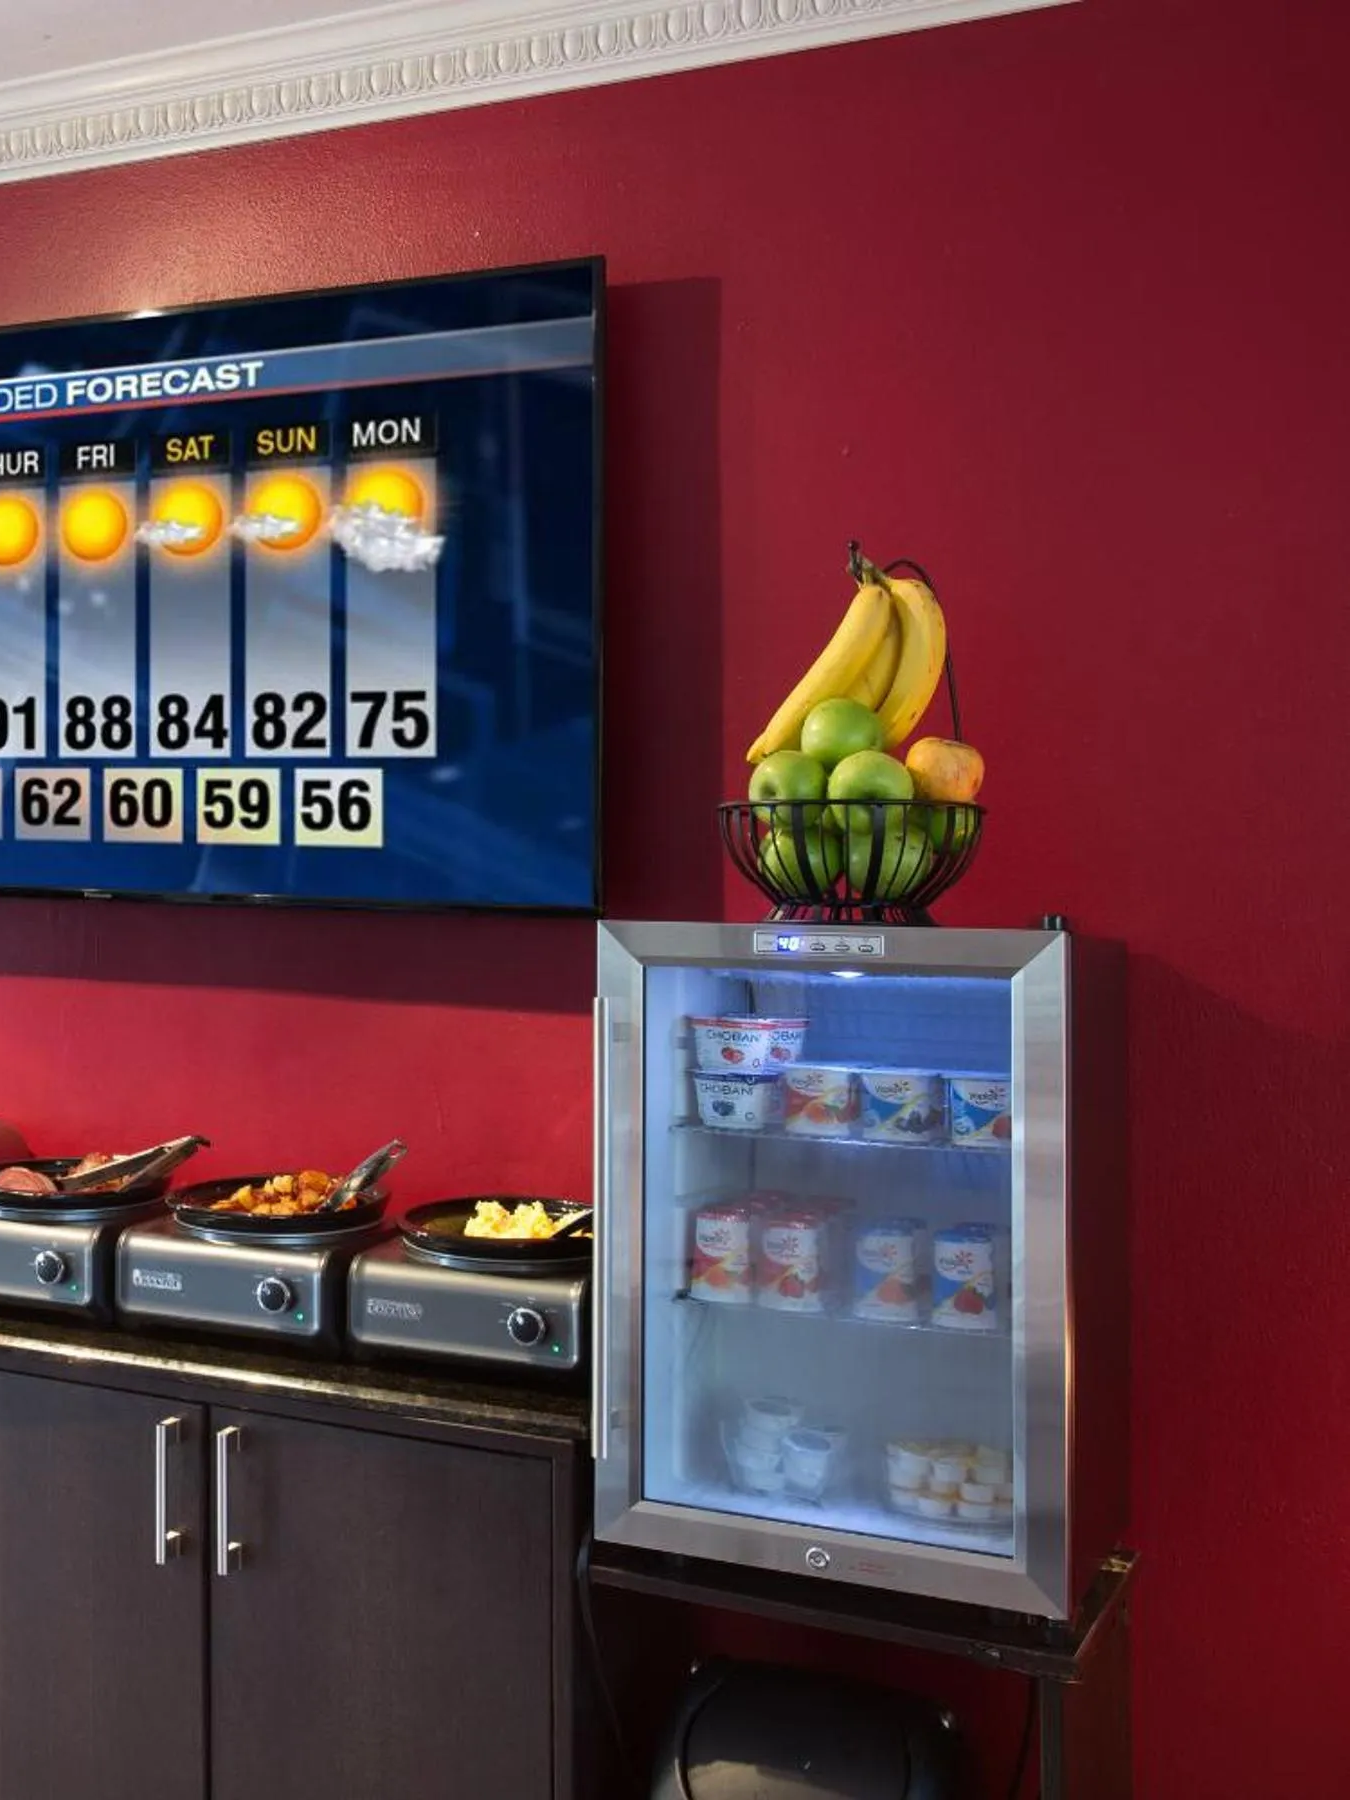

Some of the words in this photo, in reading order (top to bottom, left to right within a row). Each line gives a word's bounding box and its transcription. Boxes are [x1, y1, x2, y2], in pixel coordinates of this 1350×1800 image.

[66, 361, 264, 406] FORECAST
[77, 444, 114, 469] FRI
[167, 435, 213, 461] SAT
[258, 427, 316, 454] SUN
[353, 418, 420, 447] MON
[65, 695, 132, 750] 88
[157, 694, 228, 750] 84
[252, 691, 327, 750] 82
[350, 690, 429, 749] 75
[21, 778, 81, 826] 62
[110, 778, 172, 828] 60
[204, 779, 270, 829] 59
[301, 779, 371, 831] 56
[778, 936, 800, 952] 40
